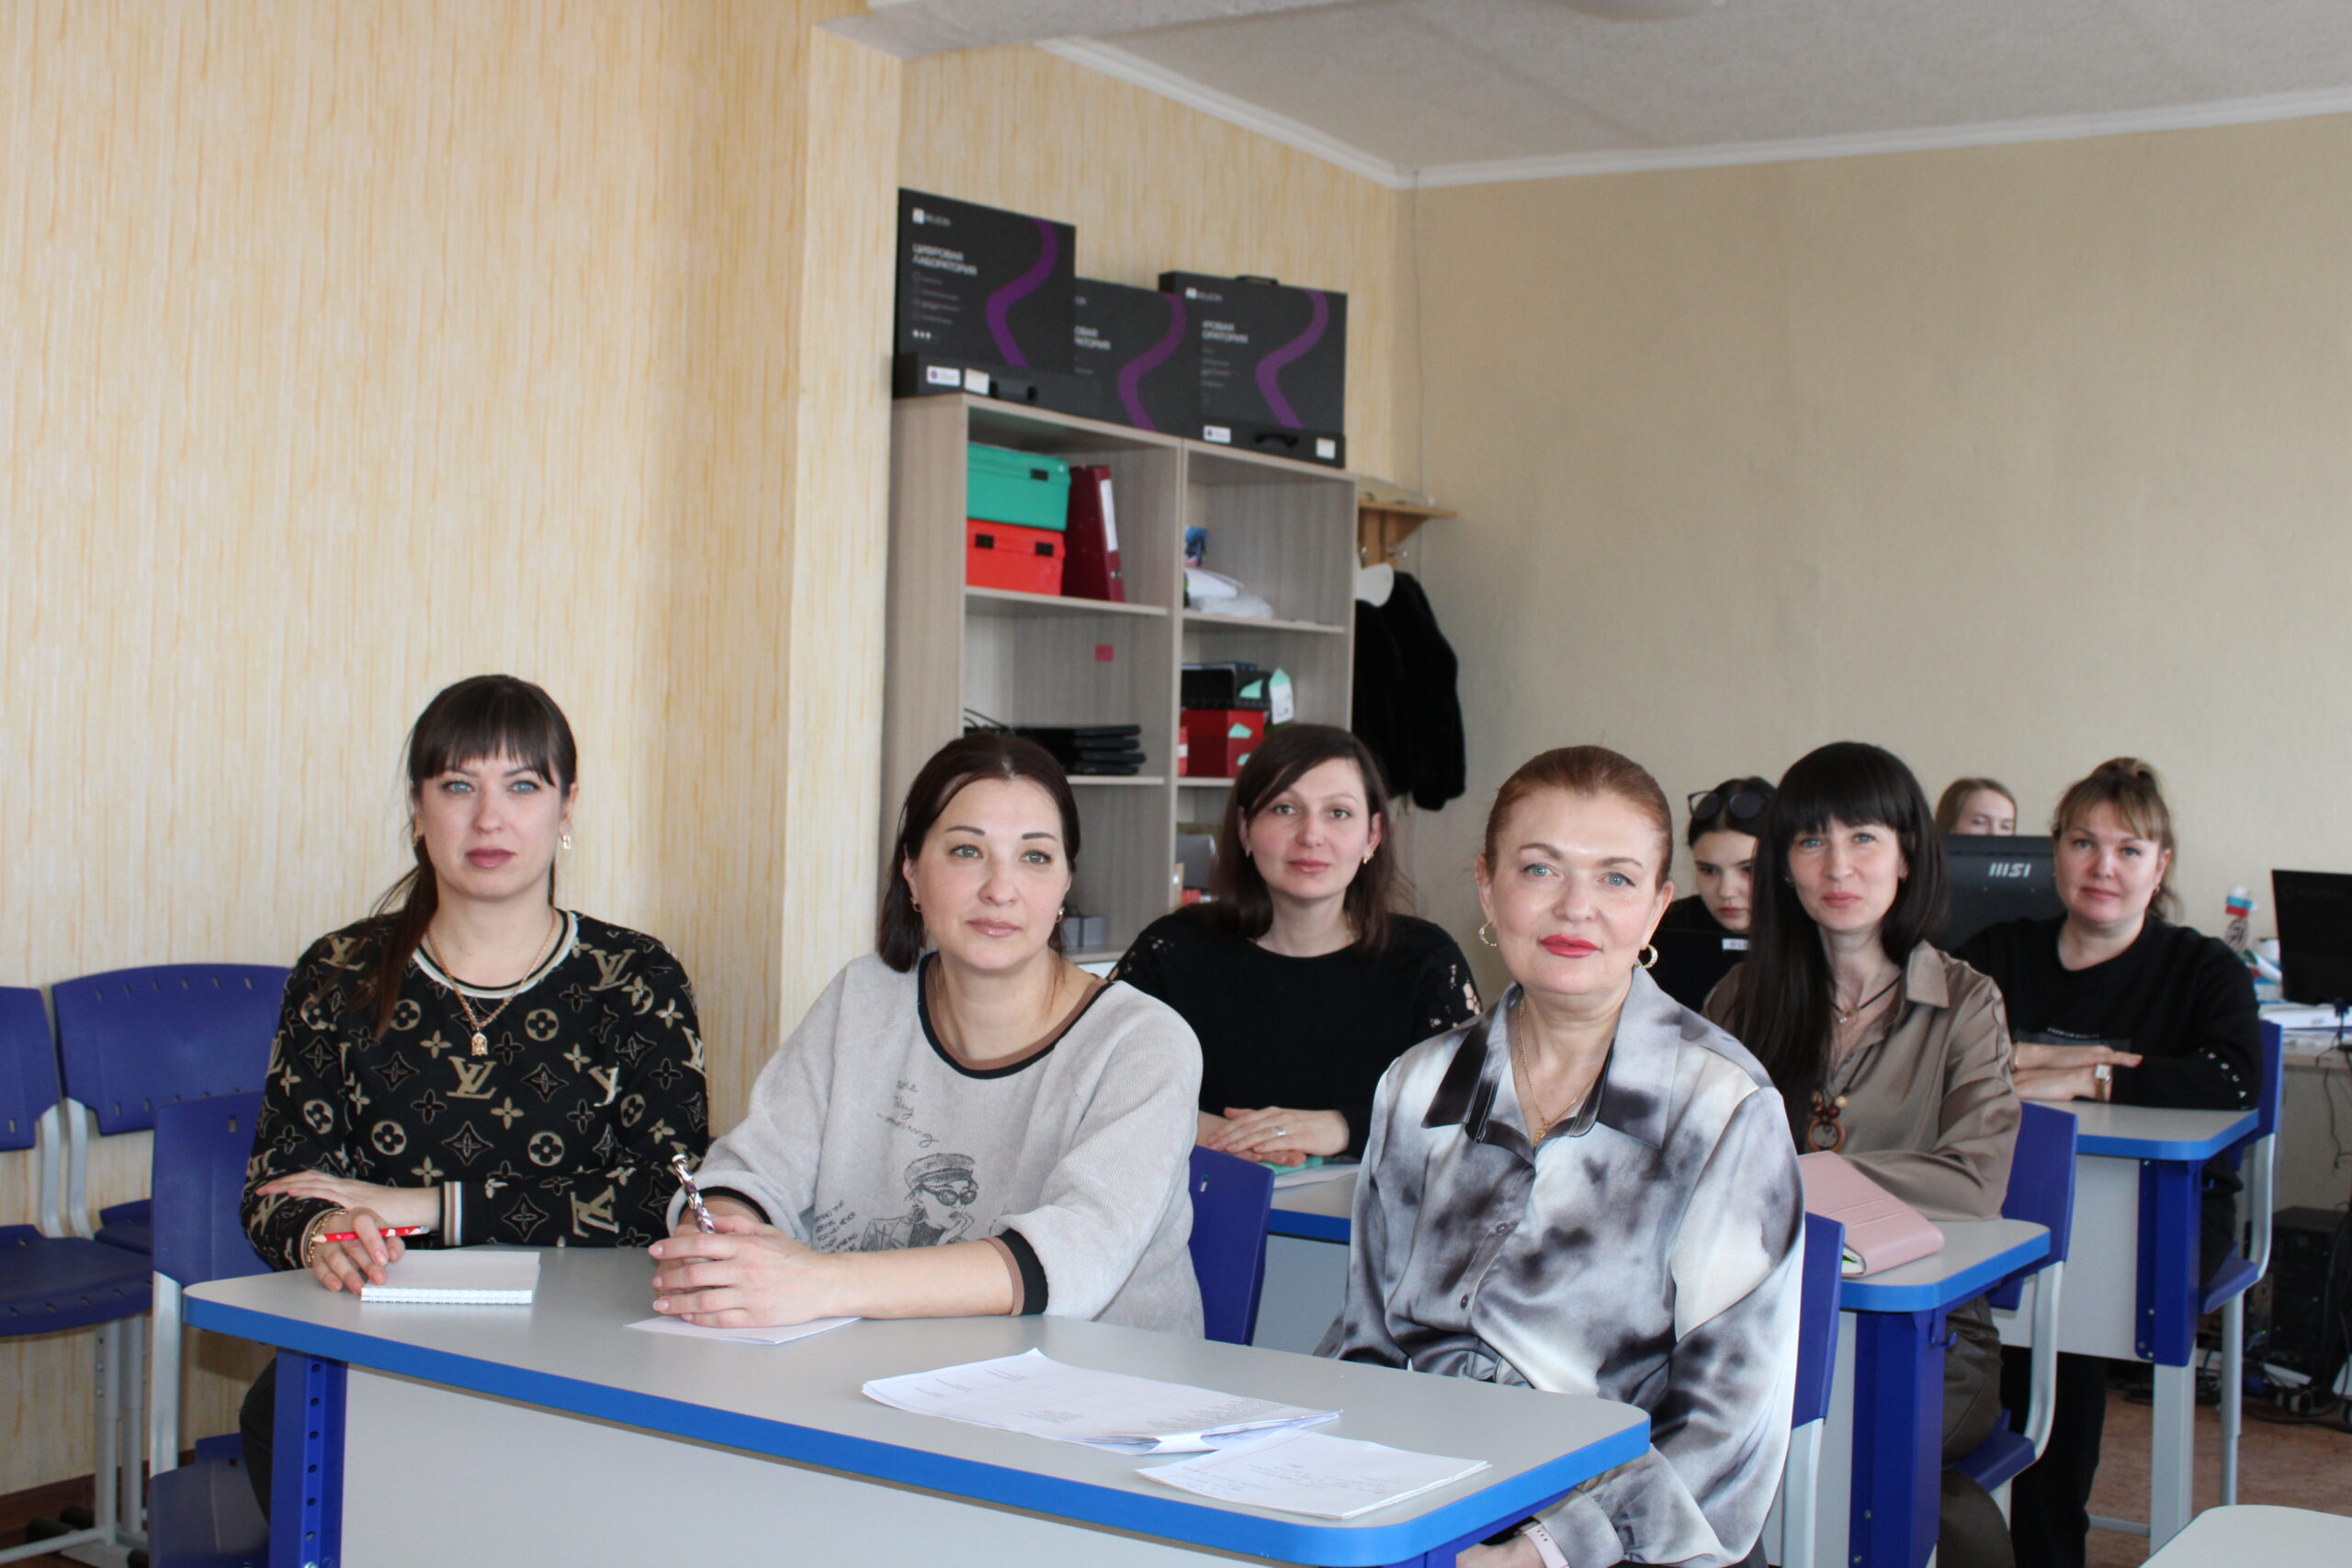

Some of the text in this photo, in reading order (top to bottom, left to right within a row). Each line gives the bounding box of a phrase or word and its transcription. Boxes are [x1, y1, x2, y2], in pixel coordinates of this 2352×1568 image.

[912, 243, 964, 262] ЦИФРОВАЯ
[912, 254, 978, 276] ЛАБОРАТОРИЯ
[1074, 325, 1098, 337] ОВАЯ
[1202, 321, 1235, 333] РОВАЯ
[1202, 330, 1249, 344] ОРАТОРИЯ
[1988, 863, 2031, 878] MSI
[447, 1055, 497, 1100] LV
